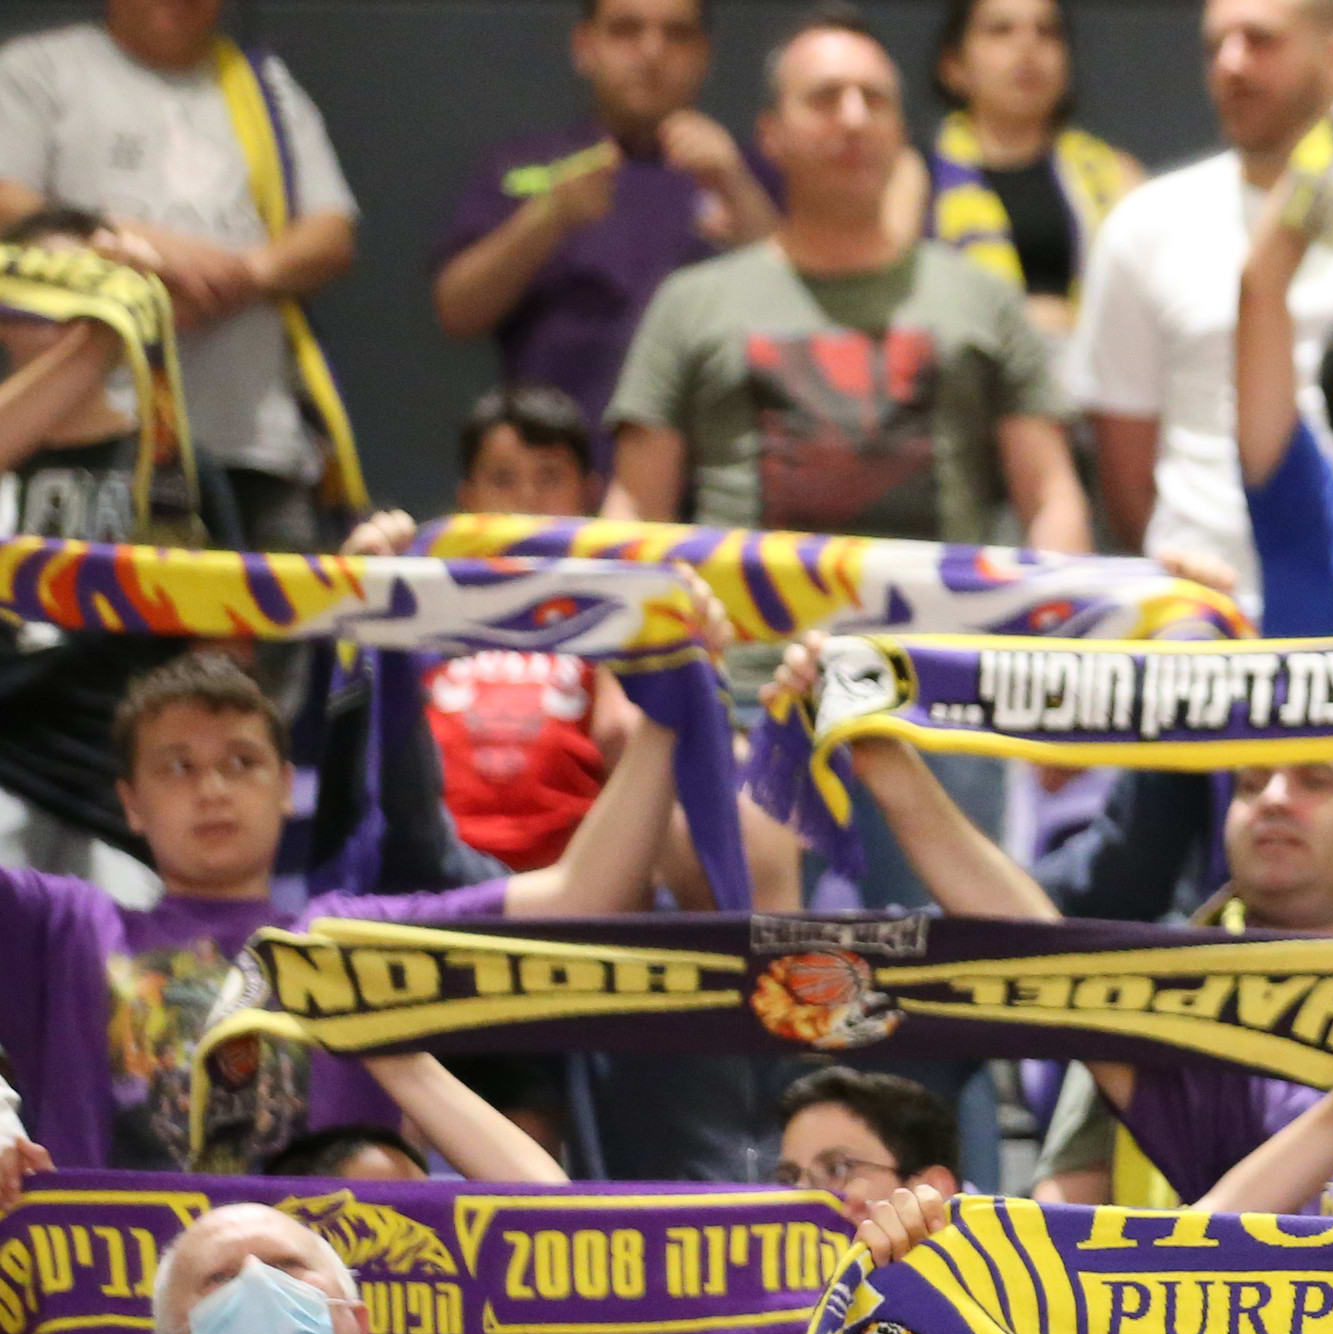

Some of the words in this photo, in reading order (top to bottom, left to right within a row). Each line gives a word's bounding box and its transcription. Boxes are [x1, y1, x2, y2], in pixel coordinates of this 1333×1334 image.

[1141, 655, 1278, 740] דימיון
[268, 942, 700, 1013] HOLON
[502, 1228, 645, 1300] 2008
[666, 1222, 853, 1297] המדינה
